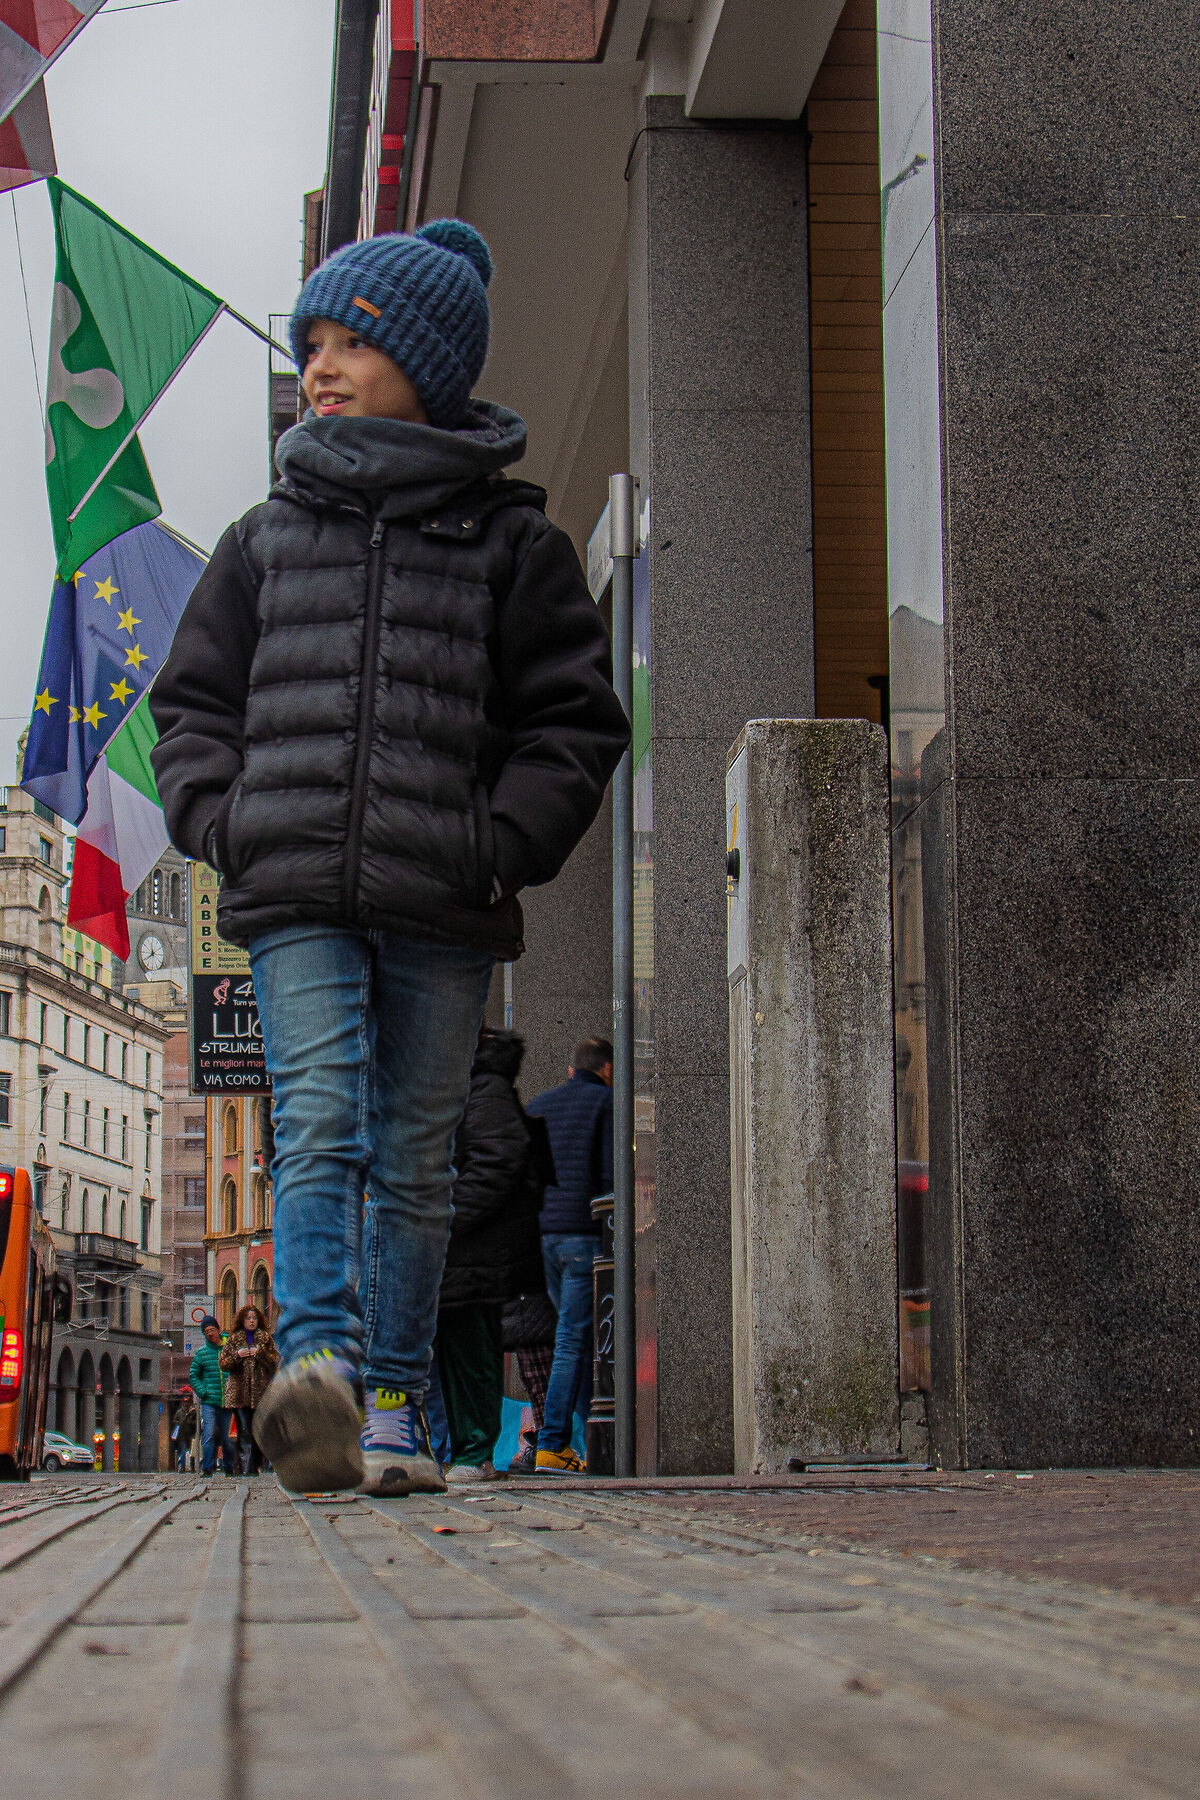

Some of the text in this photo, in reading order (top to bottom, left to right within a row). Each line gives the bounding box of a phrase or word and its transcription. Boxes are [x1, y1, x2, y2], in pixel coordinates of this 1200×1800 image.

[200, 894, 211, 905] A
[201, 910, 211, 920] B
[201, 926, 211, 936] B
[201, 942, 211, 952] C
[202, 958, 211, 968] E
[200, 1059, 210, 1068] Le
[212, 1059, 245, 1070] migliori
[203, 1074, 222, 1086] VIA
[225, 1074, 260, 1086] COMO
